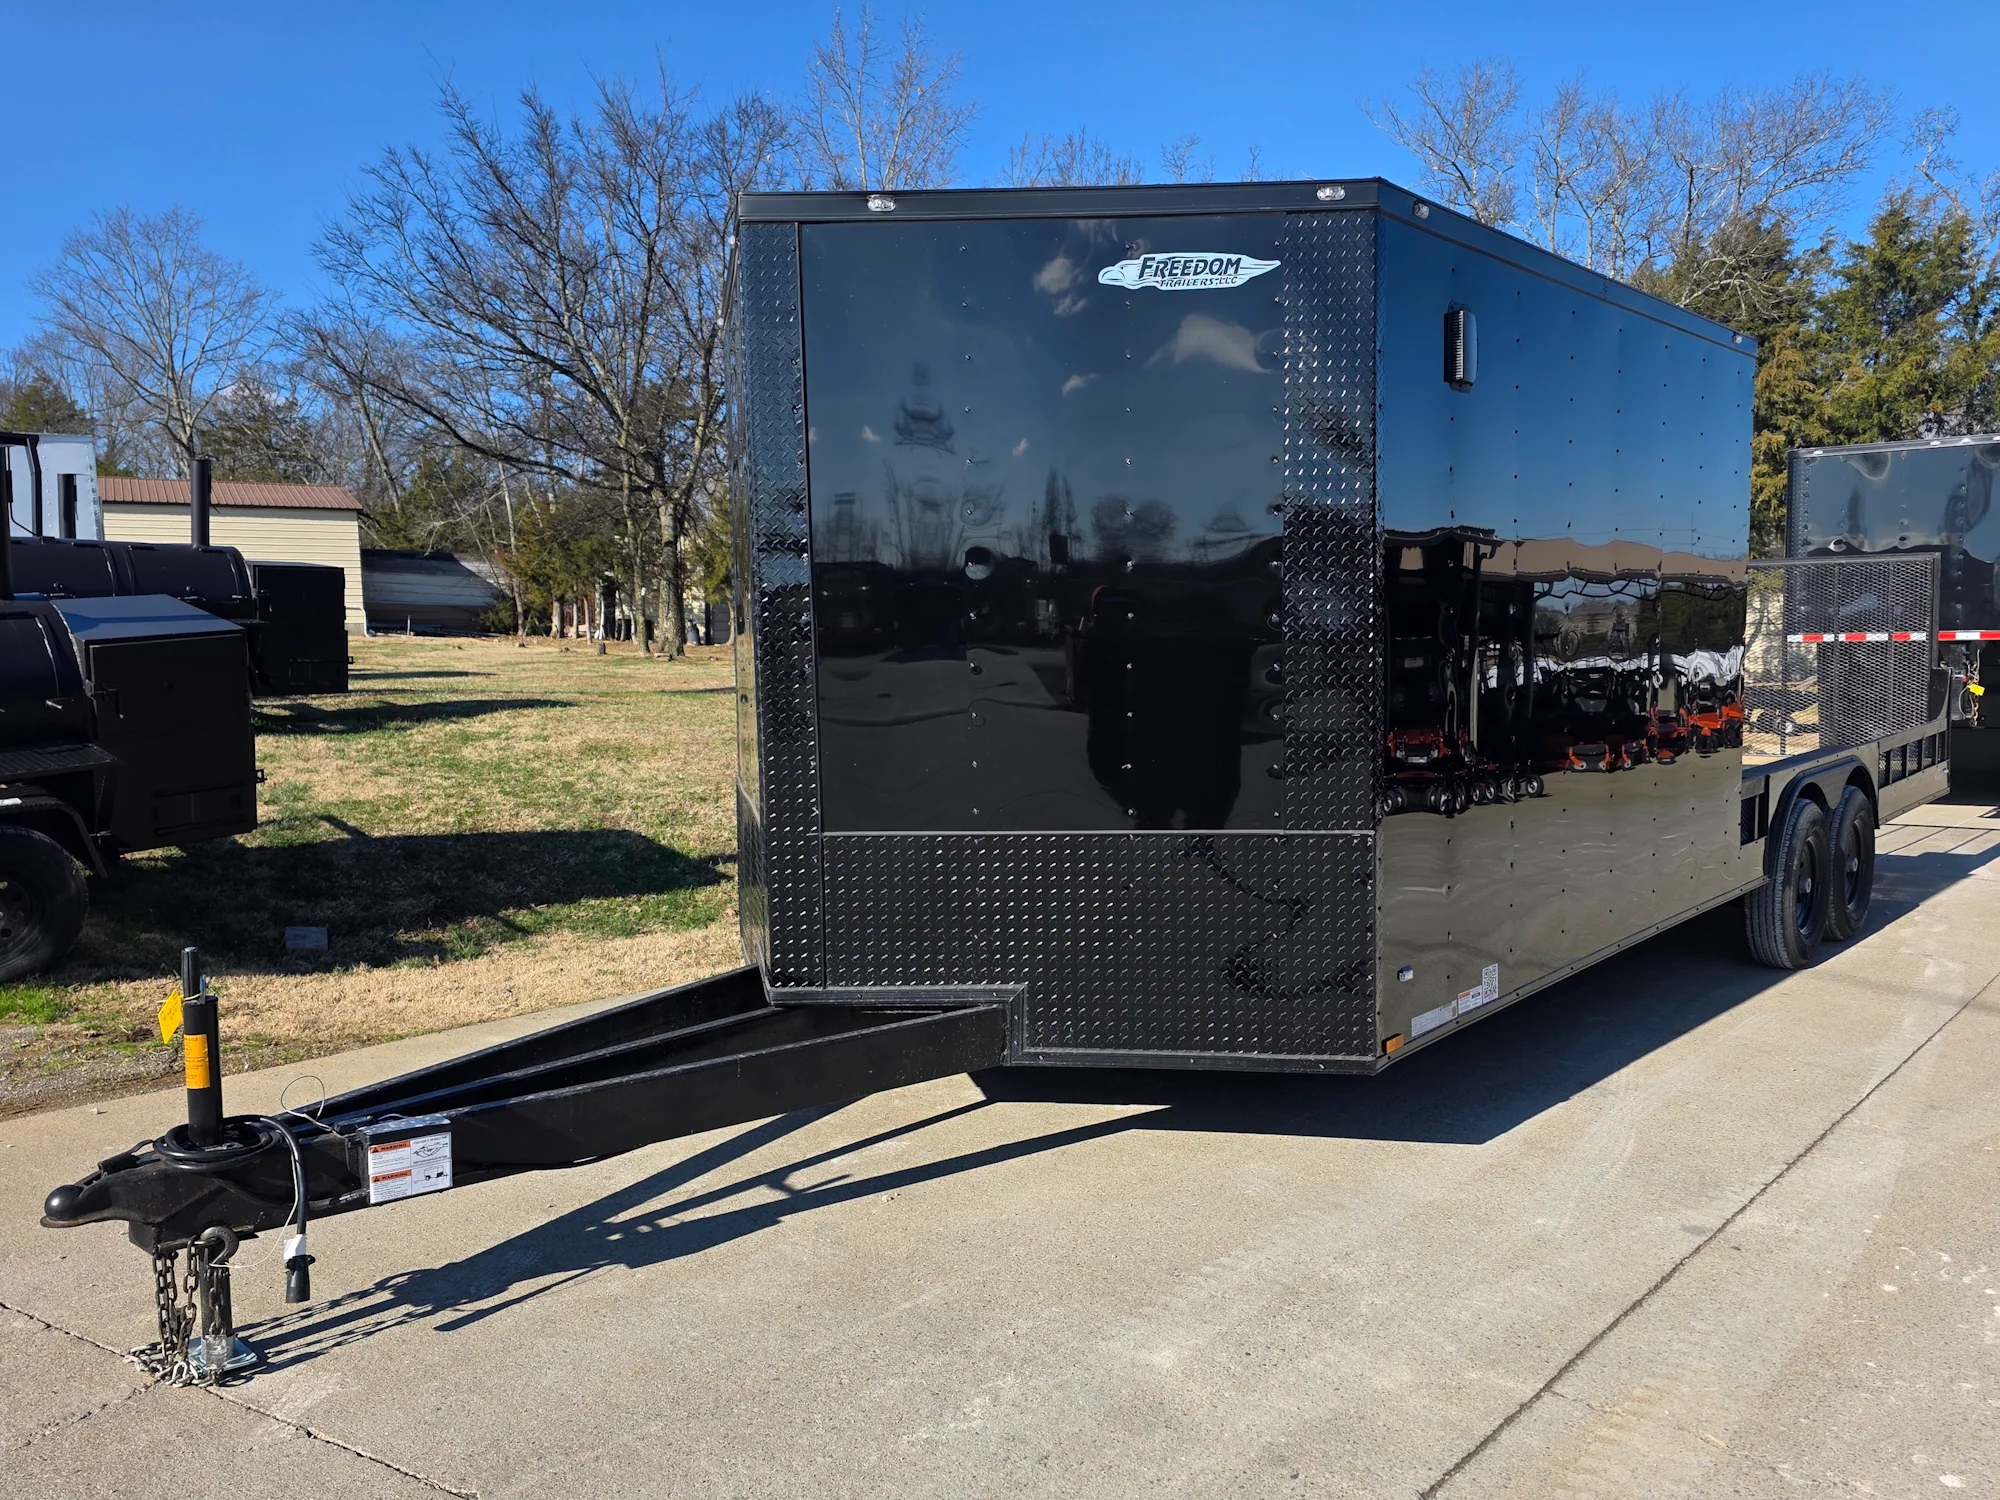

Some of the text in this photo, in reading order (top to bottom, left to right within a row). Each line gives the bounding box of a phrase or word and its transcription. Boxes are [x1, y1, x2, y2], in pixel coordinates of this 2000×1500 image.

[1138, 257, 1242, 279] FREEDOM
[380, 1142, 407, 1151] WARNING
[382, 1171, 408, 1180] WARNING
